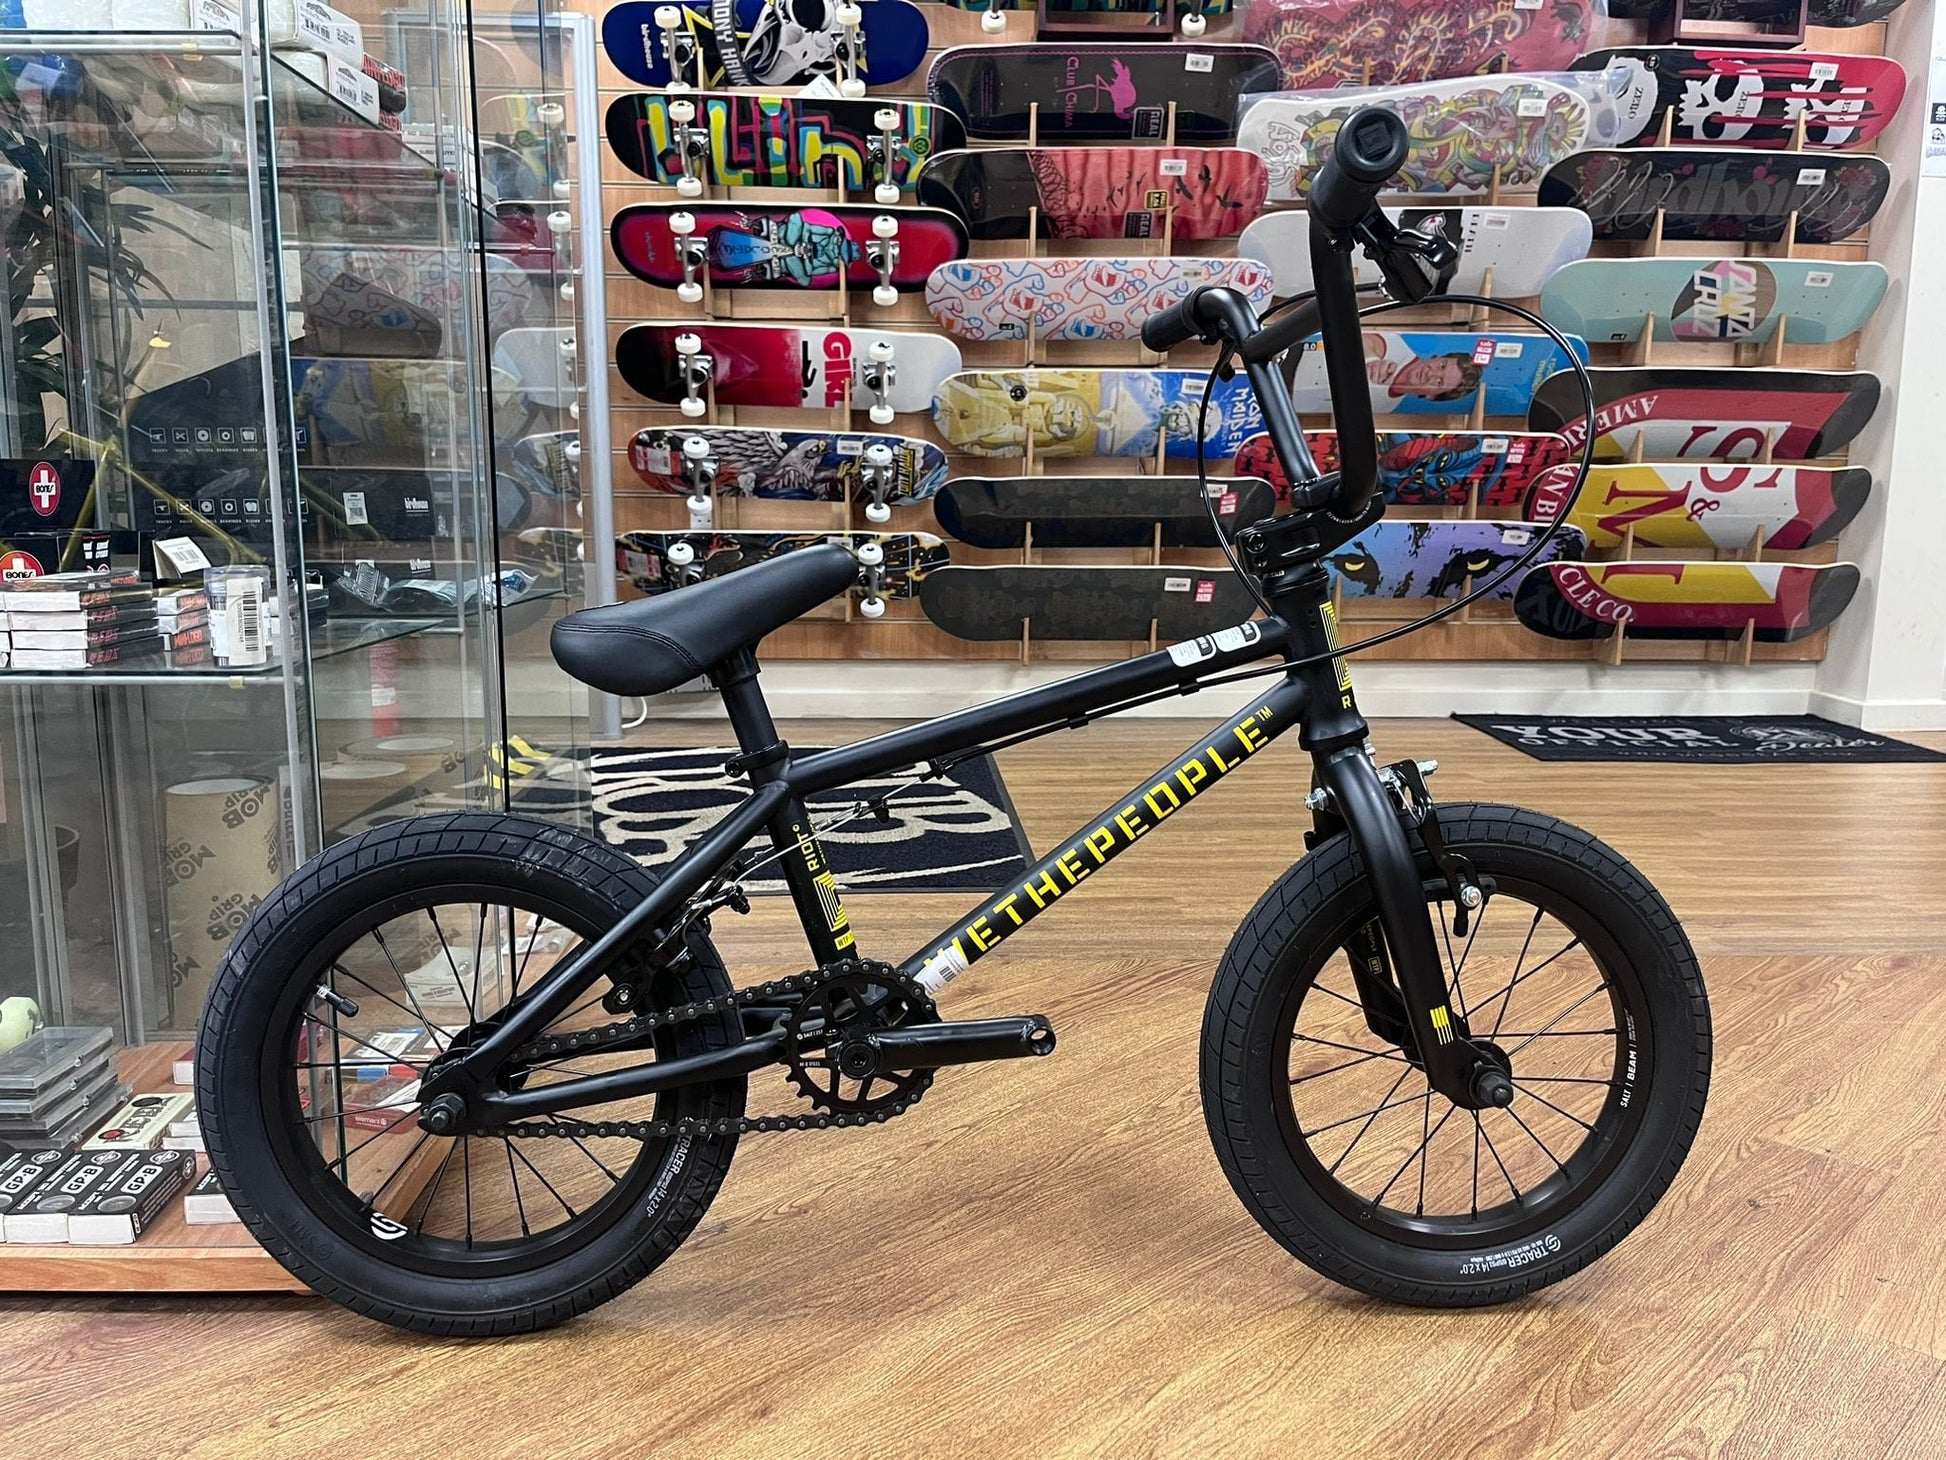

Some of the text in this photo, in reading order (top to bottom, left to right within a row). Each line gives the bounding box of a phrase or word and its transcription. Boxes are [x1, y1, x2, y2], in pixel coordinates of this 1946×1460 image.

[1066, 56, 1079, 86] CLUB
[1627, 86, 1645, 121] ZERO
[1693, 269, 1722, 337] CRUZ
[1728, 260, 1757, 338] SANTA
[36, 484, 54, 494] BONES
[5, 570, 34, 579] BONES
[1491, 725, 1719, 740] YOUR
[221, 785, 271, 829] MOB
[1619, 1089, 1632, 1109] SALT
[1626, 1049, 1638, 1082] BEAM
[670, 1134, 693, 1175] TRACER
[1508, 1248, 1549, 1268] TRACER
